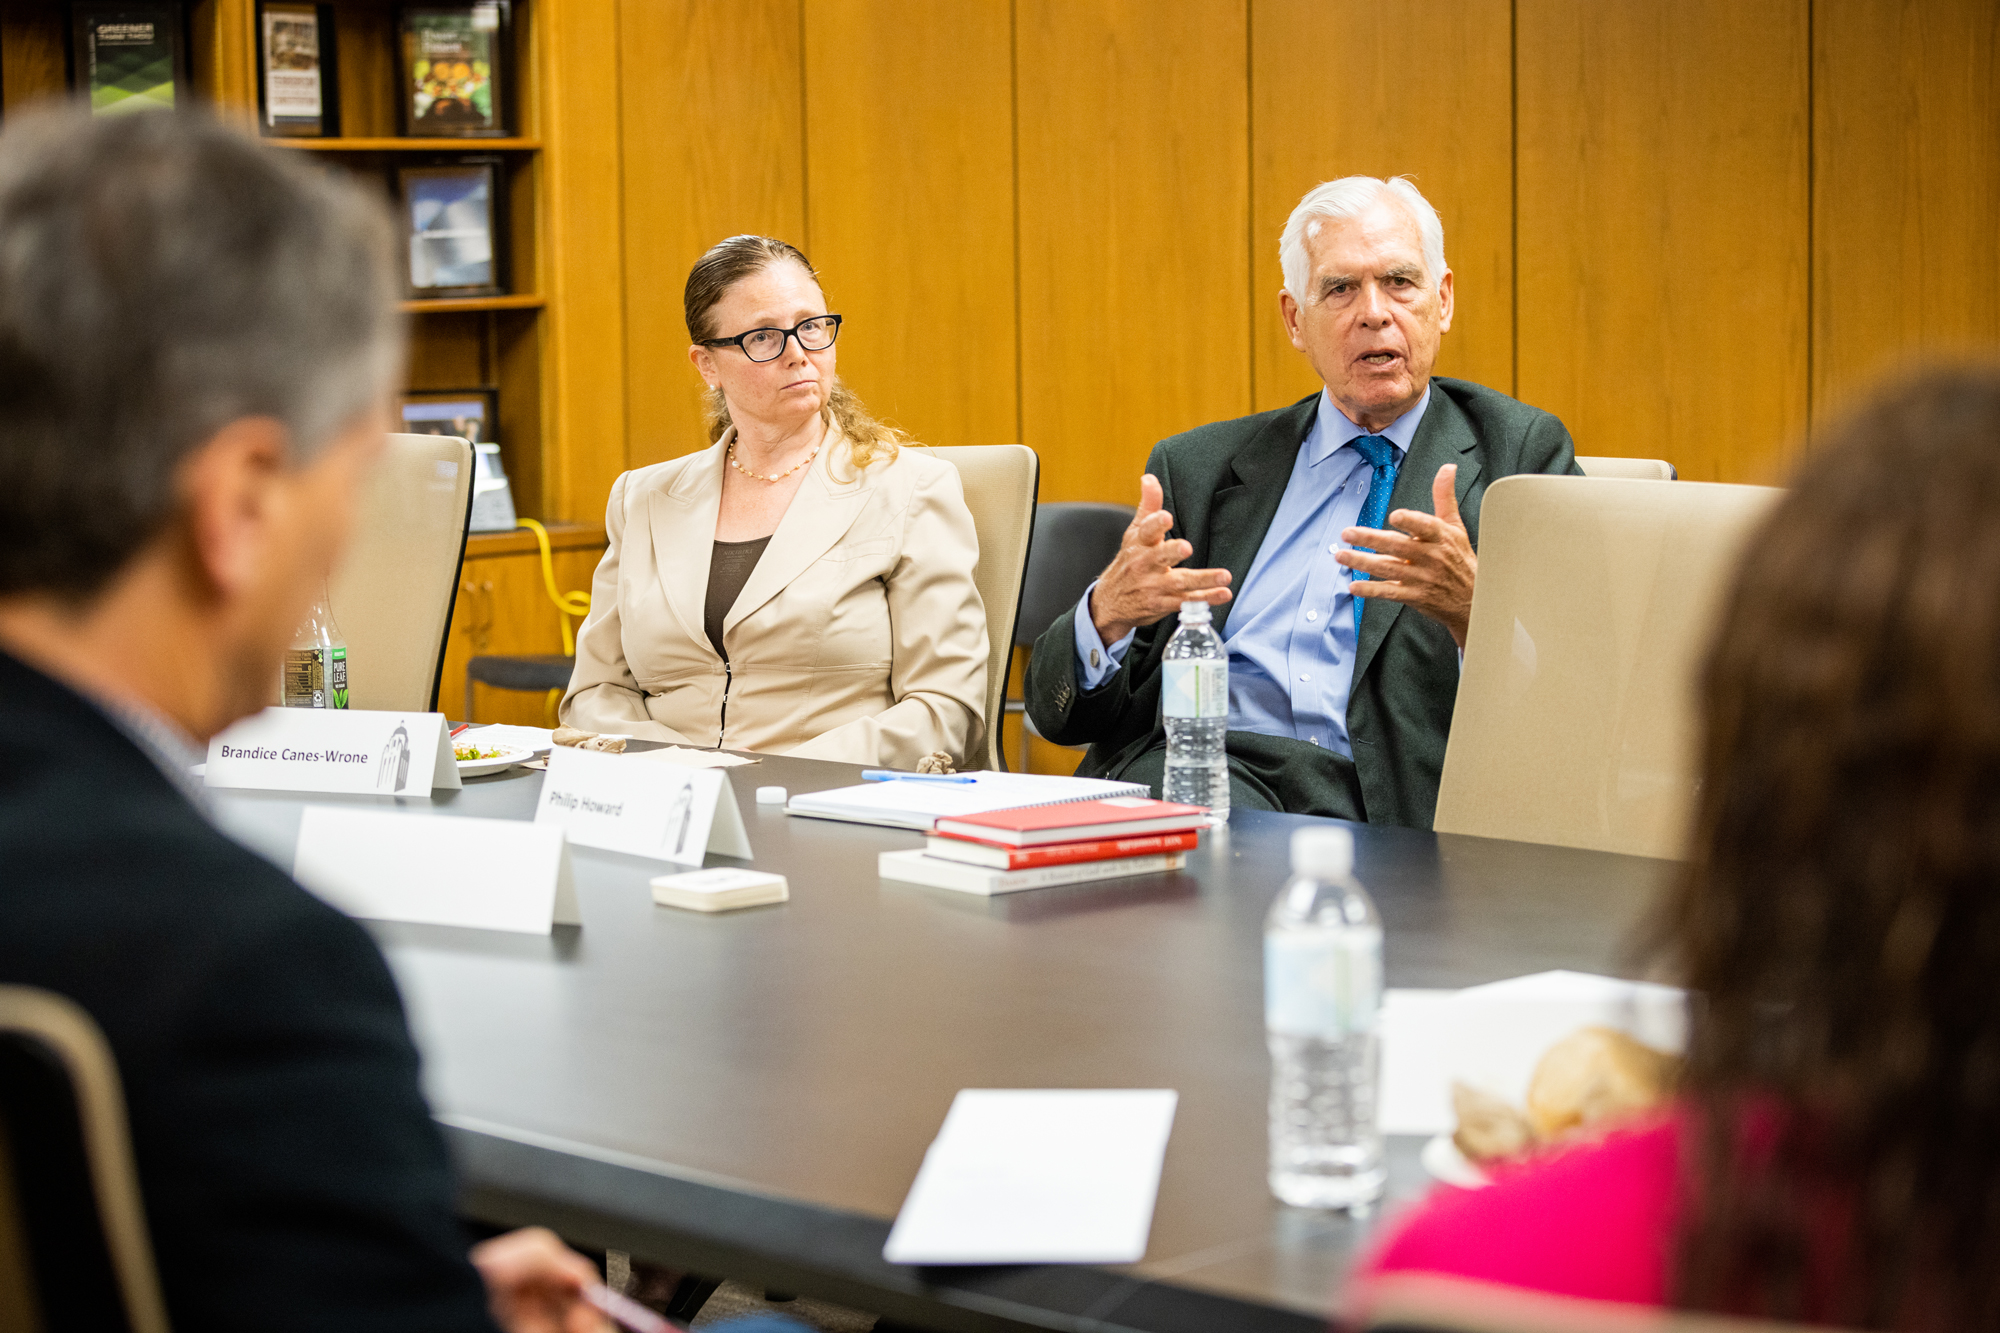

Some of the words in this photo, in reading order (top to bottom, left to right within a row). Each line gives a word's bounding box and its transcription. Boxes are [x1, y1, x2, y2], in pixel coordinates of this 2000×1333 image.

[97, 23, 154, 34] GREENER
[334, 662, 346, 672] PURE
[334, 672, 346, 682] LEAF
[221, 745, 277, 760] Brandice
[281, 748, 368, 764] Canes-Wrone
[549, 791, 578, 812] Philip
[581, 796, 624, 817] Howard
